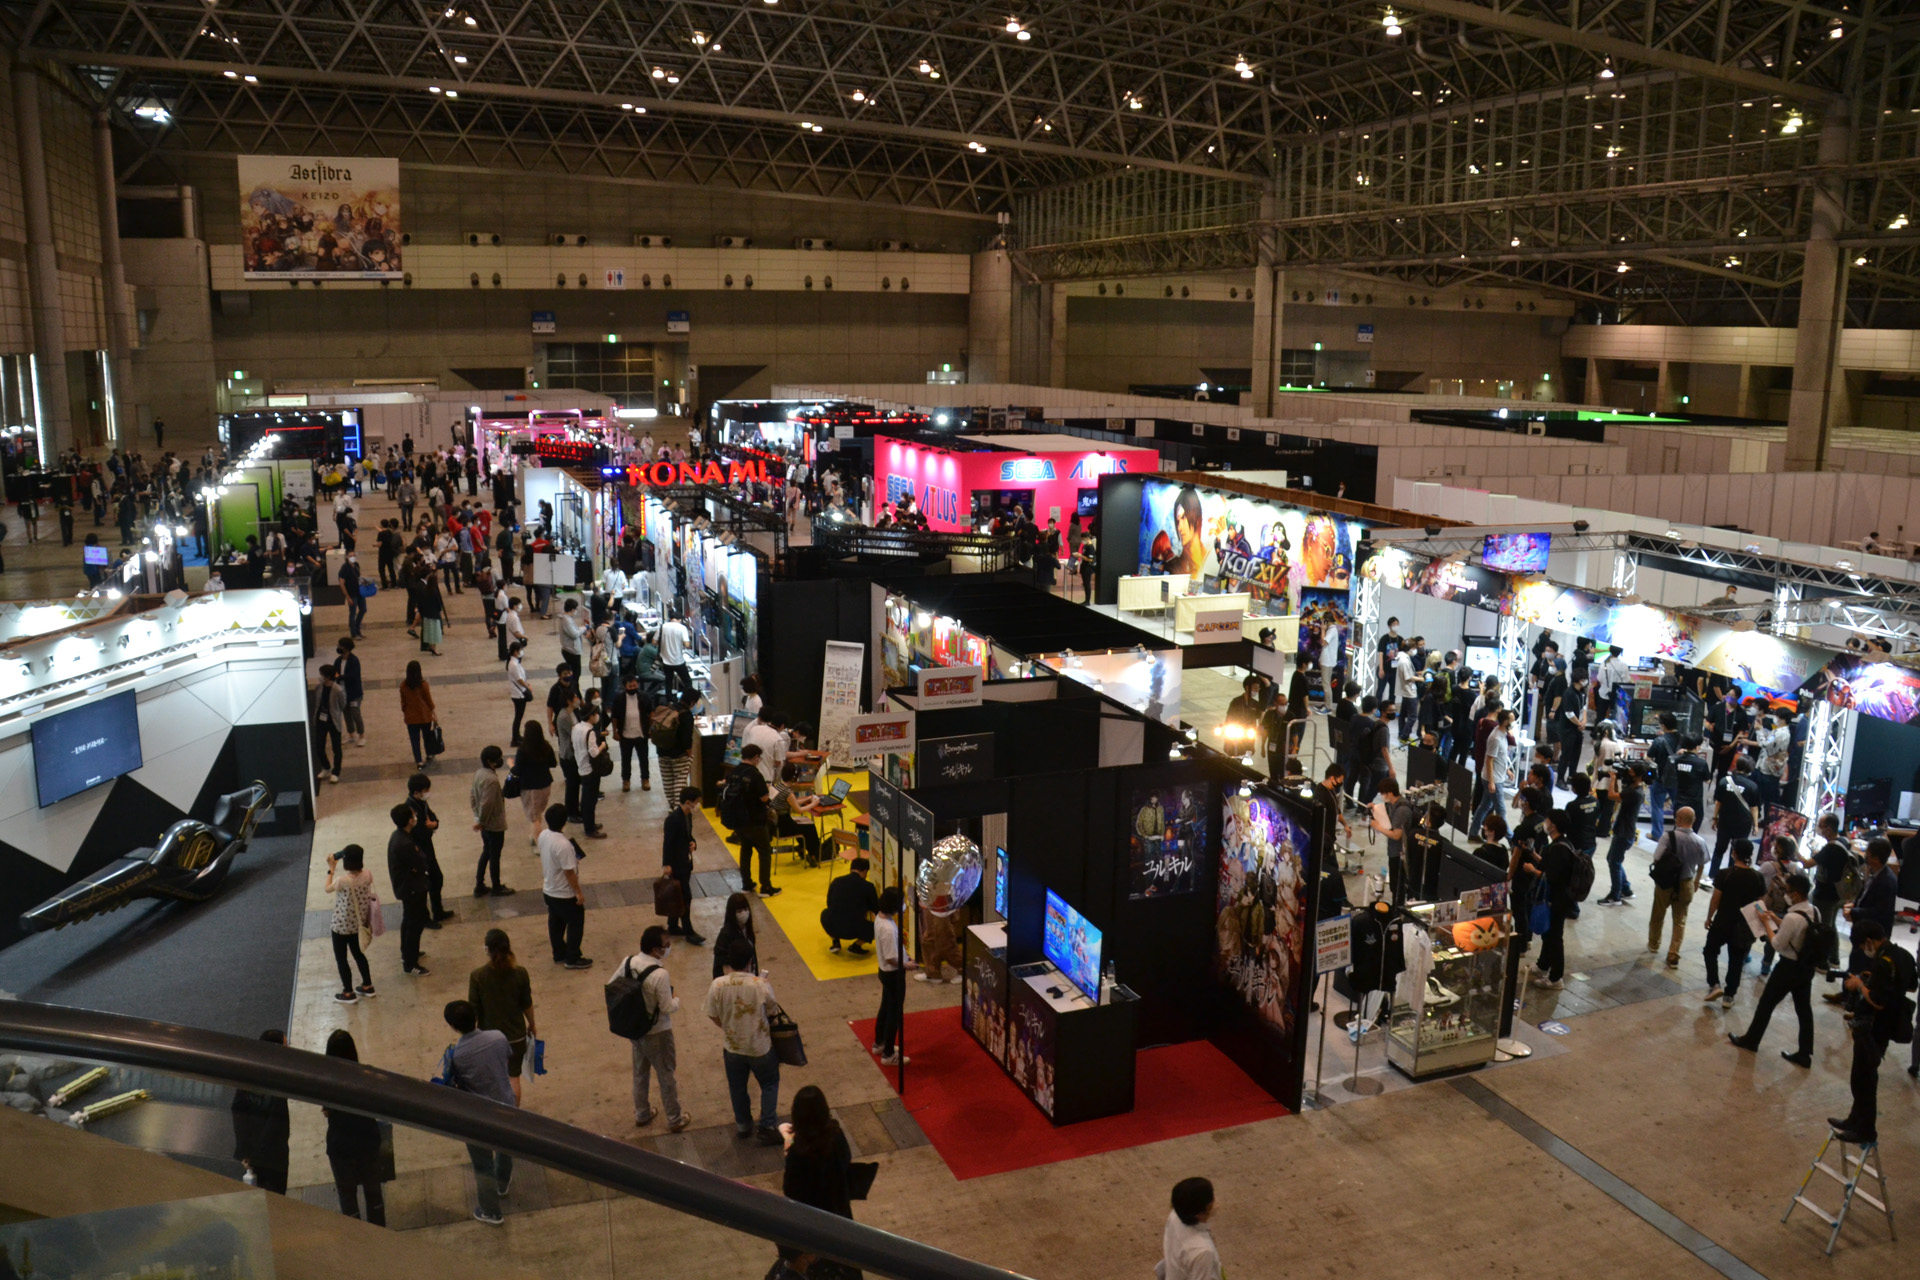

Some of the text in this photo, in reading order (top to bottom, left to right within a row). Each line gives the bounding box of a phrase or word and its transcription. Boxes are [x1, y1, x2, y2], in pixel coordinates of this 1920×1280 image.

[628, 460, 768, 486] KONAMI
[1001, 460, 1056, 480] SEGA
[921, 484, 957, 524] ATLUS
[1196, 621, 1239, 632] CAPCOM
[1726, 783, 1745, 794] SFF
[1143, 856, 1192, 880] ユルキル
